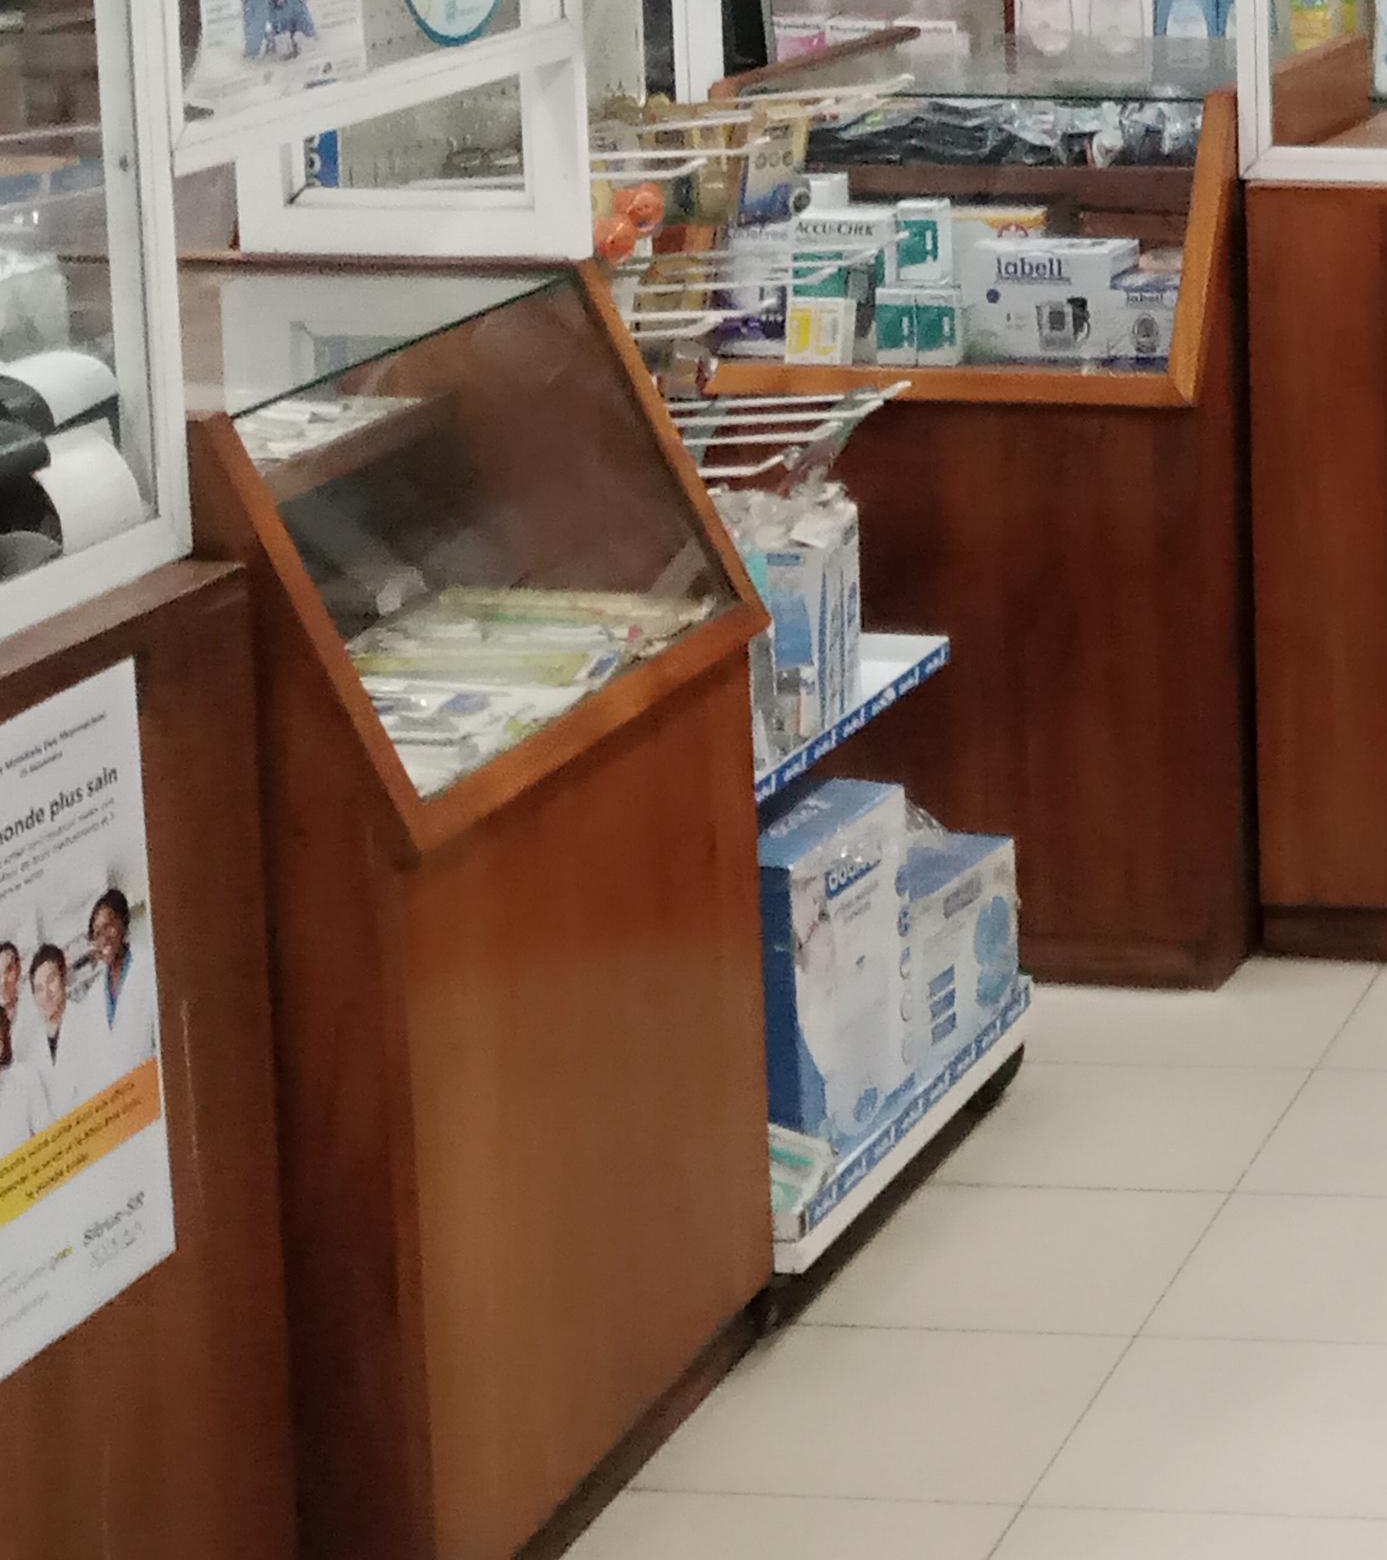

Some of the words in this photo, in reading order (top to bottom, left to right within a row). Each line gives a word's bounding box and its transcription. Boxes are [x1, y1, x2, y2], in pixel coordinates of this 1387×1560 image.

[996, 256, 1063, 278] labell
[49, 787, 84, 822] plus
[86, 766, 118, 798] sain
